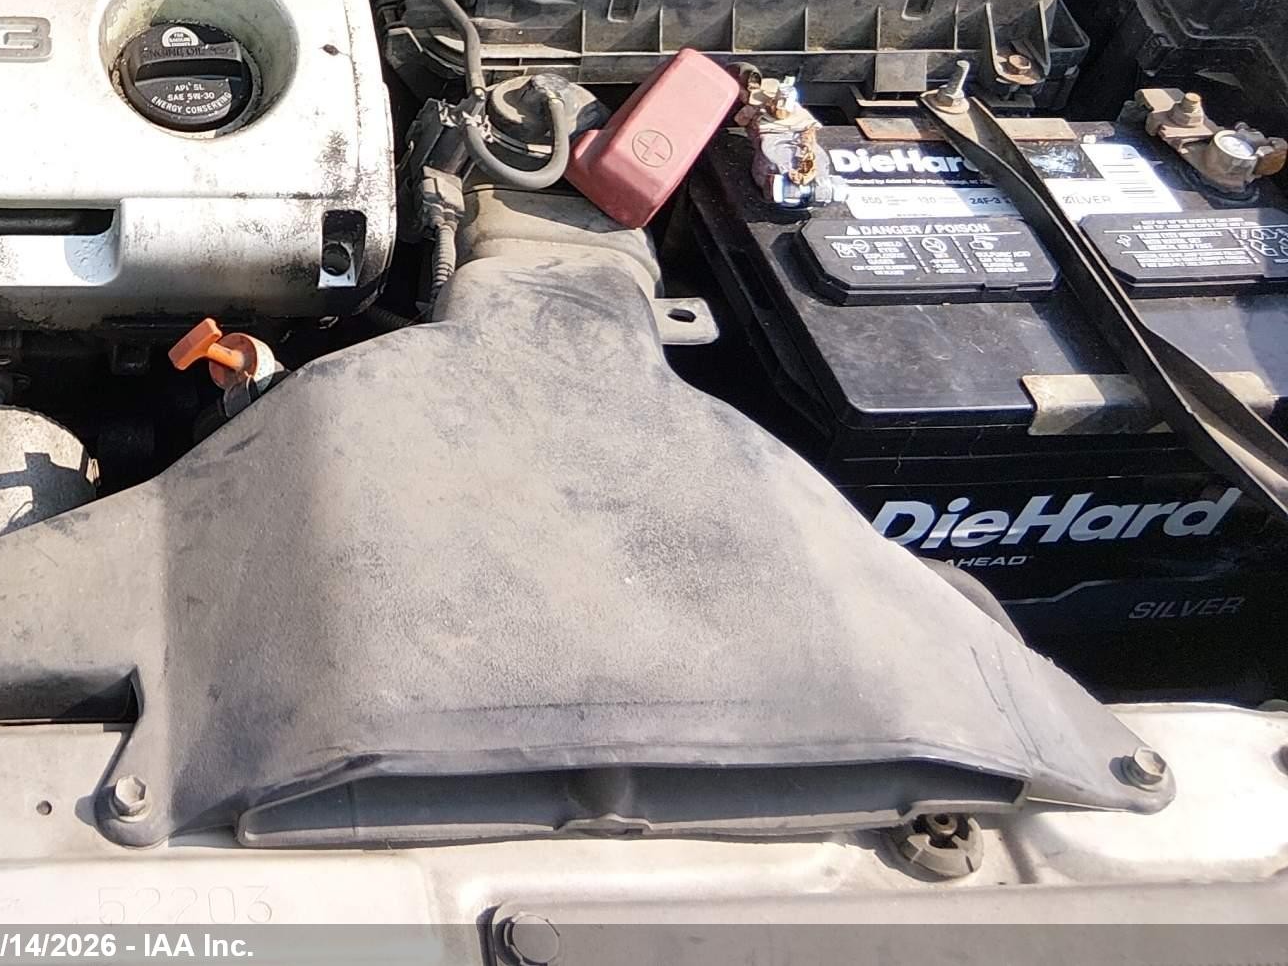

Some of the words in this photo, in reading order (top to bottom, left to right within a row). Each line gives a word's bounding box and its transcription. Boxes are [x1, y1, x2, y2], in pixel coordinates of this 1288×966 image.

[151, 96, 183, 113] ENERGY
[185, 92, 233, 114] CONSERVING
[167, 93, 185, 101] SAE
[187, 92, 215, 101] 5W-30
[859, 225, 923, 235] DANGER
[935, 223, 990, 233] POISON
[871, 487, 1243, 550] DieHard
[1128, 596, 1247, 620] SILVER
[97, 884, 274, 925] 52203
